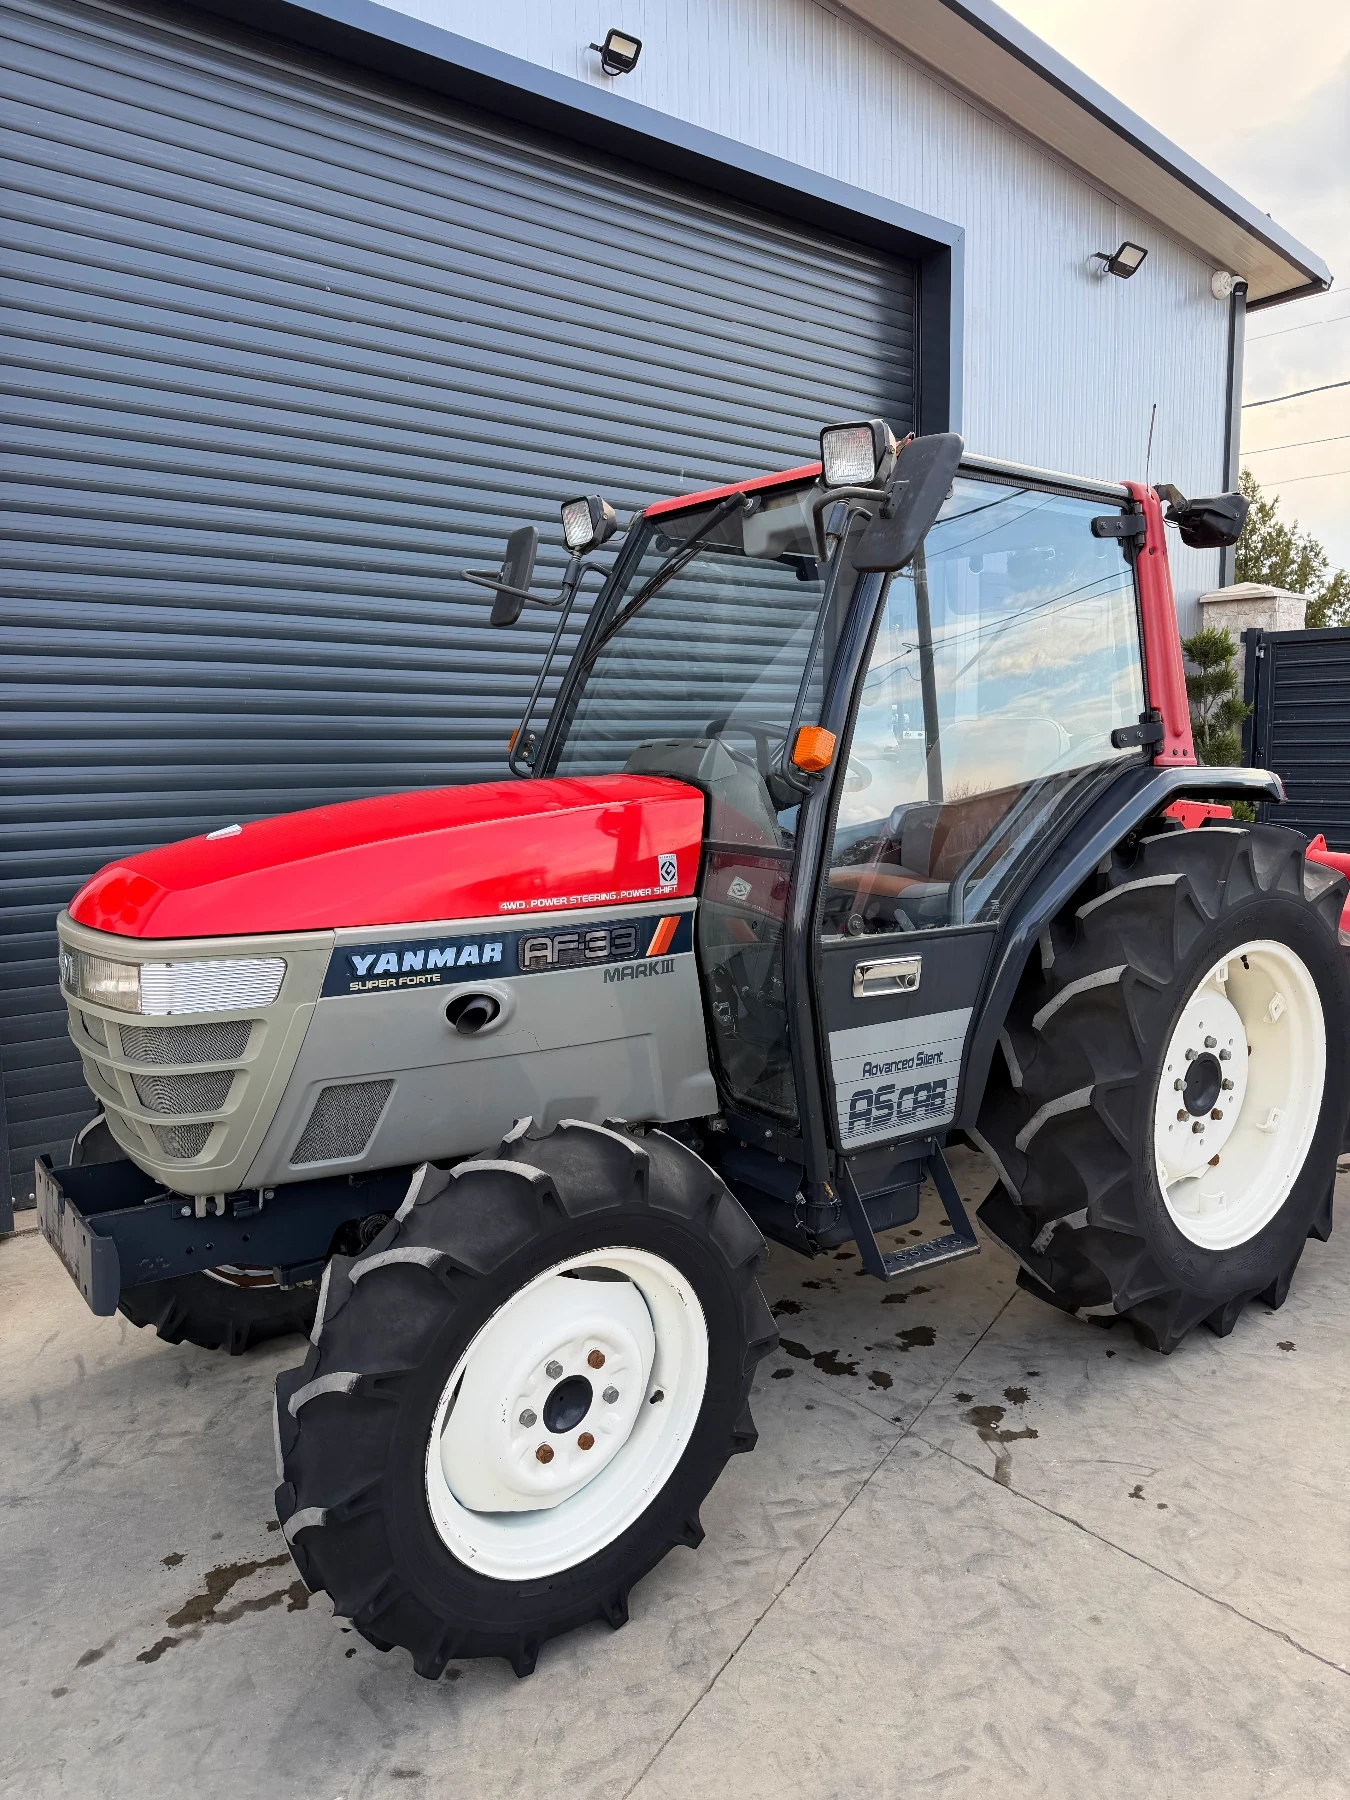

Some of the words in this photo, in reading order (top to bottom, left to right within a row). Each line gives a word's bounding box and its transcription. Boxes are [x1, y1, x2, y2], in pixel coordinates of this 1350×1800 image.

[530, 896, 567, 908] POWER
[620, 888, 652, 899] POWER
[653, 885, 678, 895] SHIFT
[351, 942, 503, 976] YANMAR
[349, 979, 397, 991] SUPER
[398, 973, 441, 986] FORTE
[862, 1057, 914, 1077] Advanced
[915, 1050, 944, 1068] Silent
